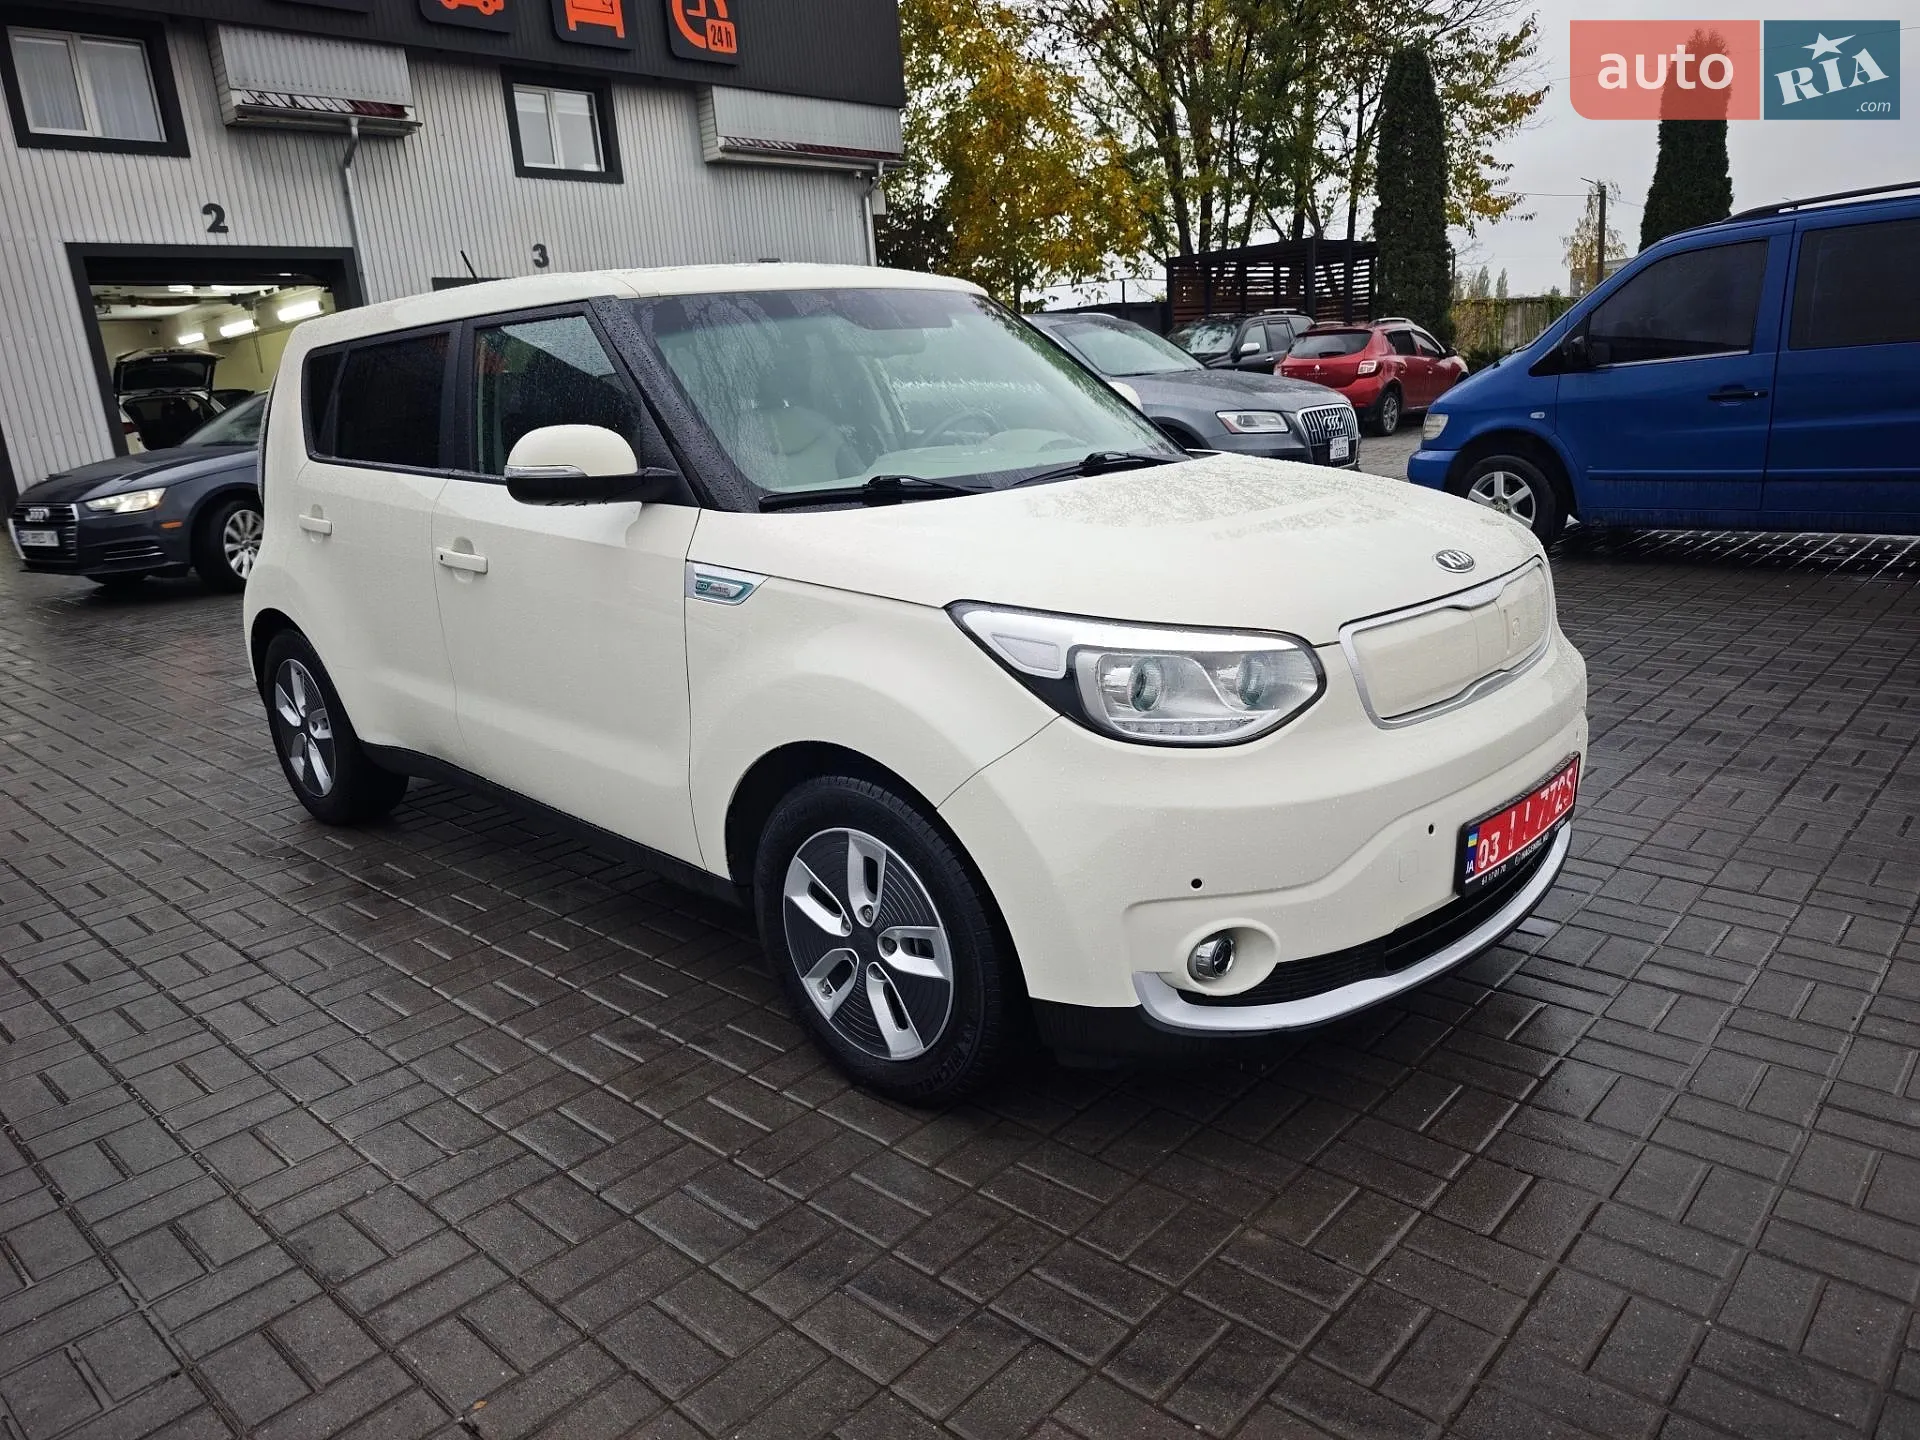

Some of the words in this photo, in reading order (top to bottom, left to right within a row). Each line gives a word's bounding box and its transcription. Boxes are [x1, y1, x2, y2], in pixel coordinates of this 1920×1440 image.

[202, 203, 229, 233] 2
[533, 244, 549, 268] 3
[1478, 831, 1501, 869] 03
